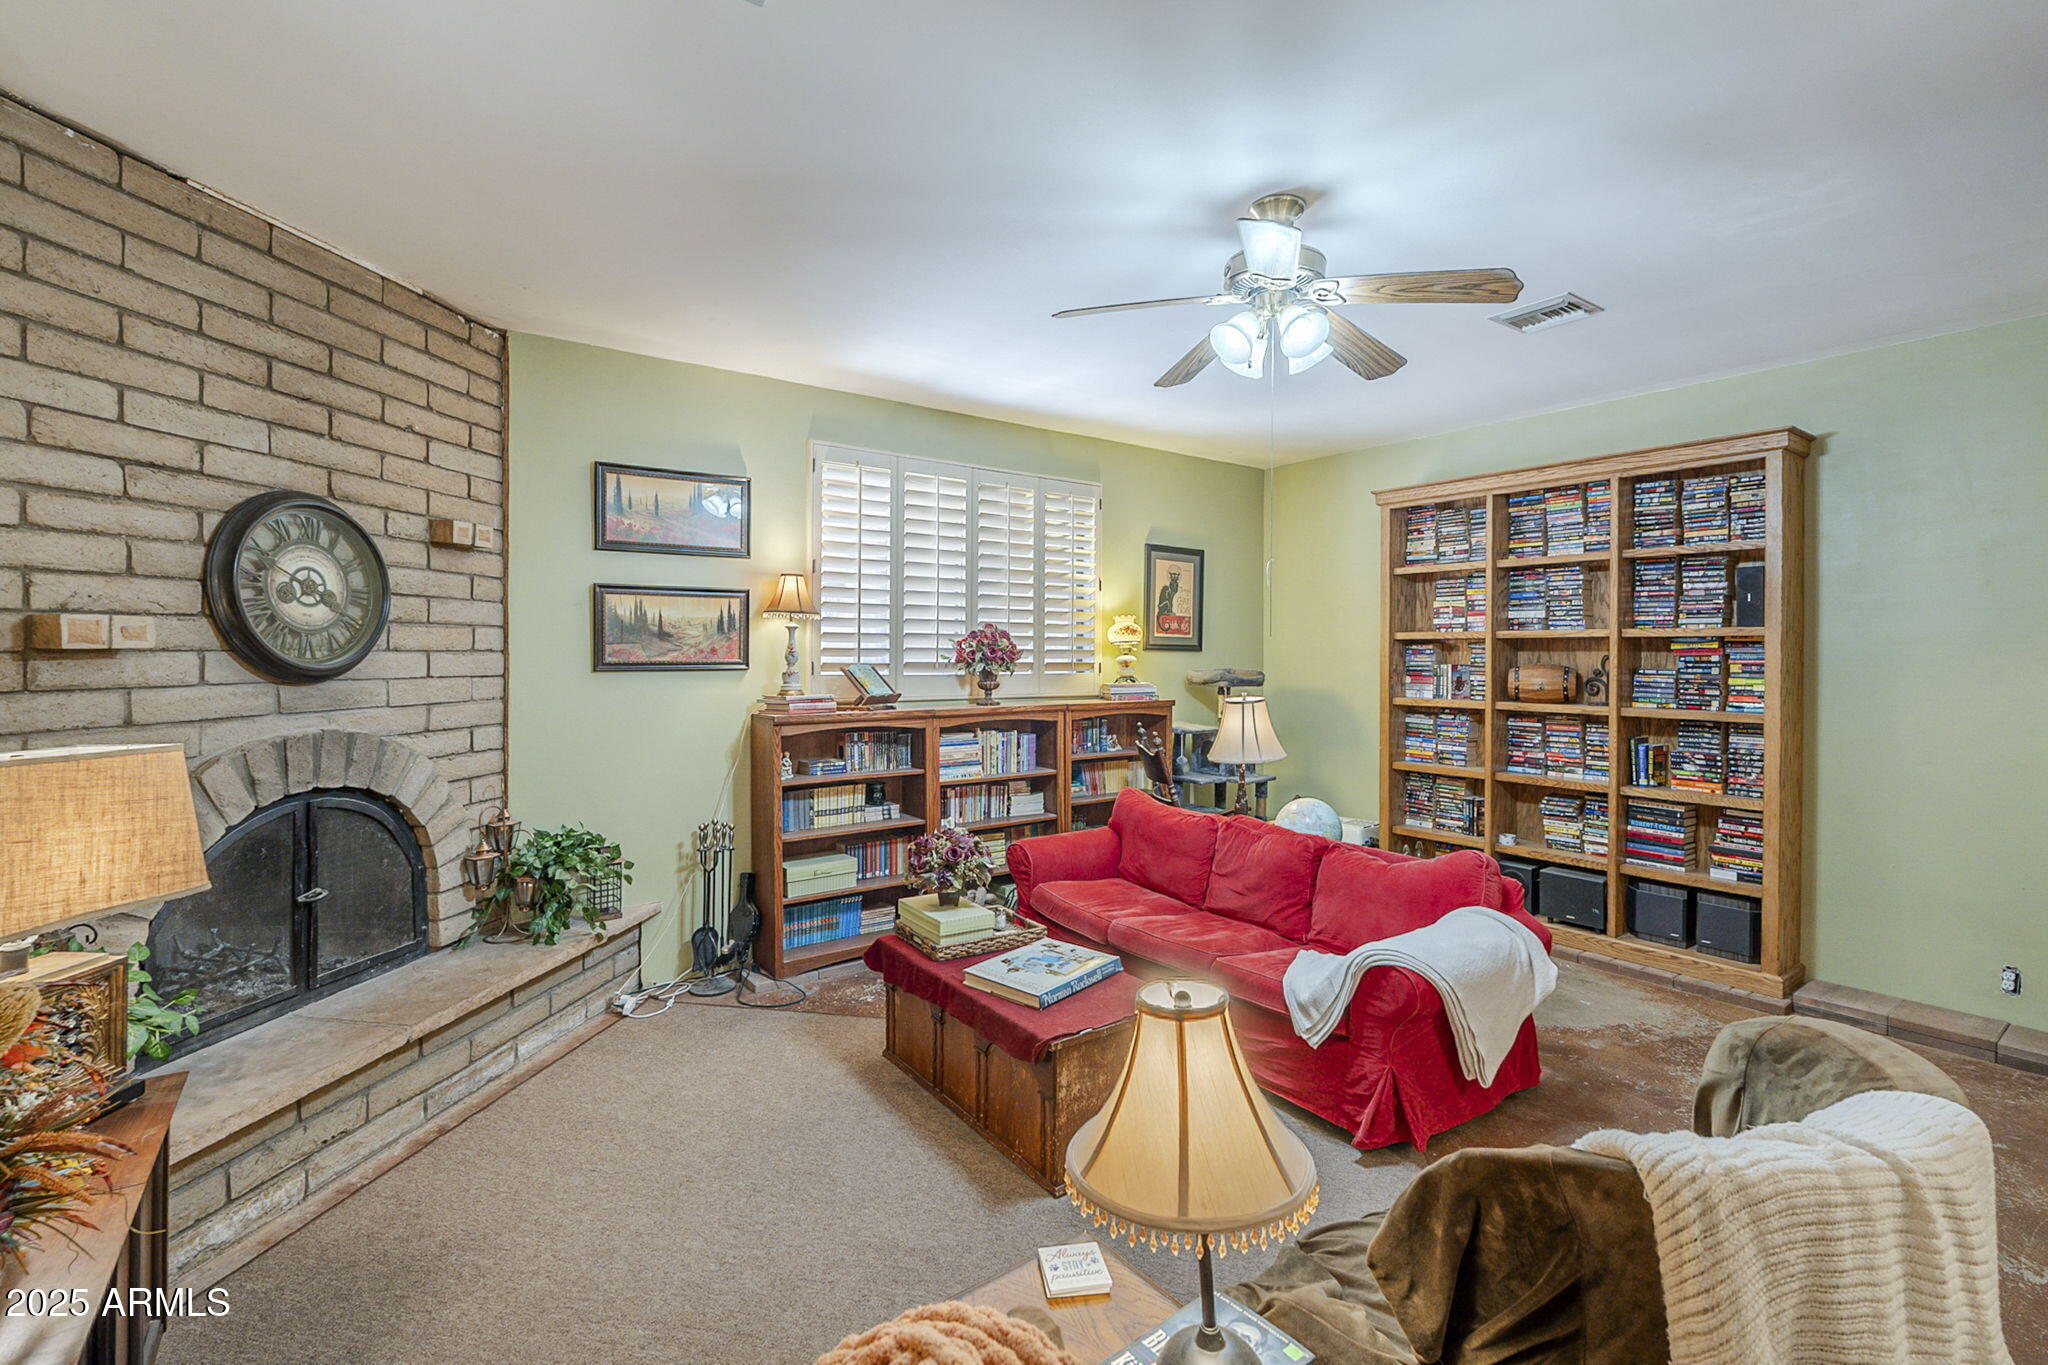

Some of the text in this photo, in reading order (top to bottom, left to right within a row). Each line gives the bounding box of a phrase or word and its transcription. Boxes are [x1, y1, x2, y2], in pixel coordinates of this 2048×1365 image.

[1041, 987, 1072, 1006] Norman
[1071, 968, 1103, 993] Rockwell
[1045, 1247, 1096, 1263] Always
[1061, 1260, 1084, 1271] STAY
